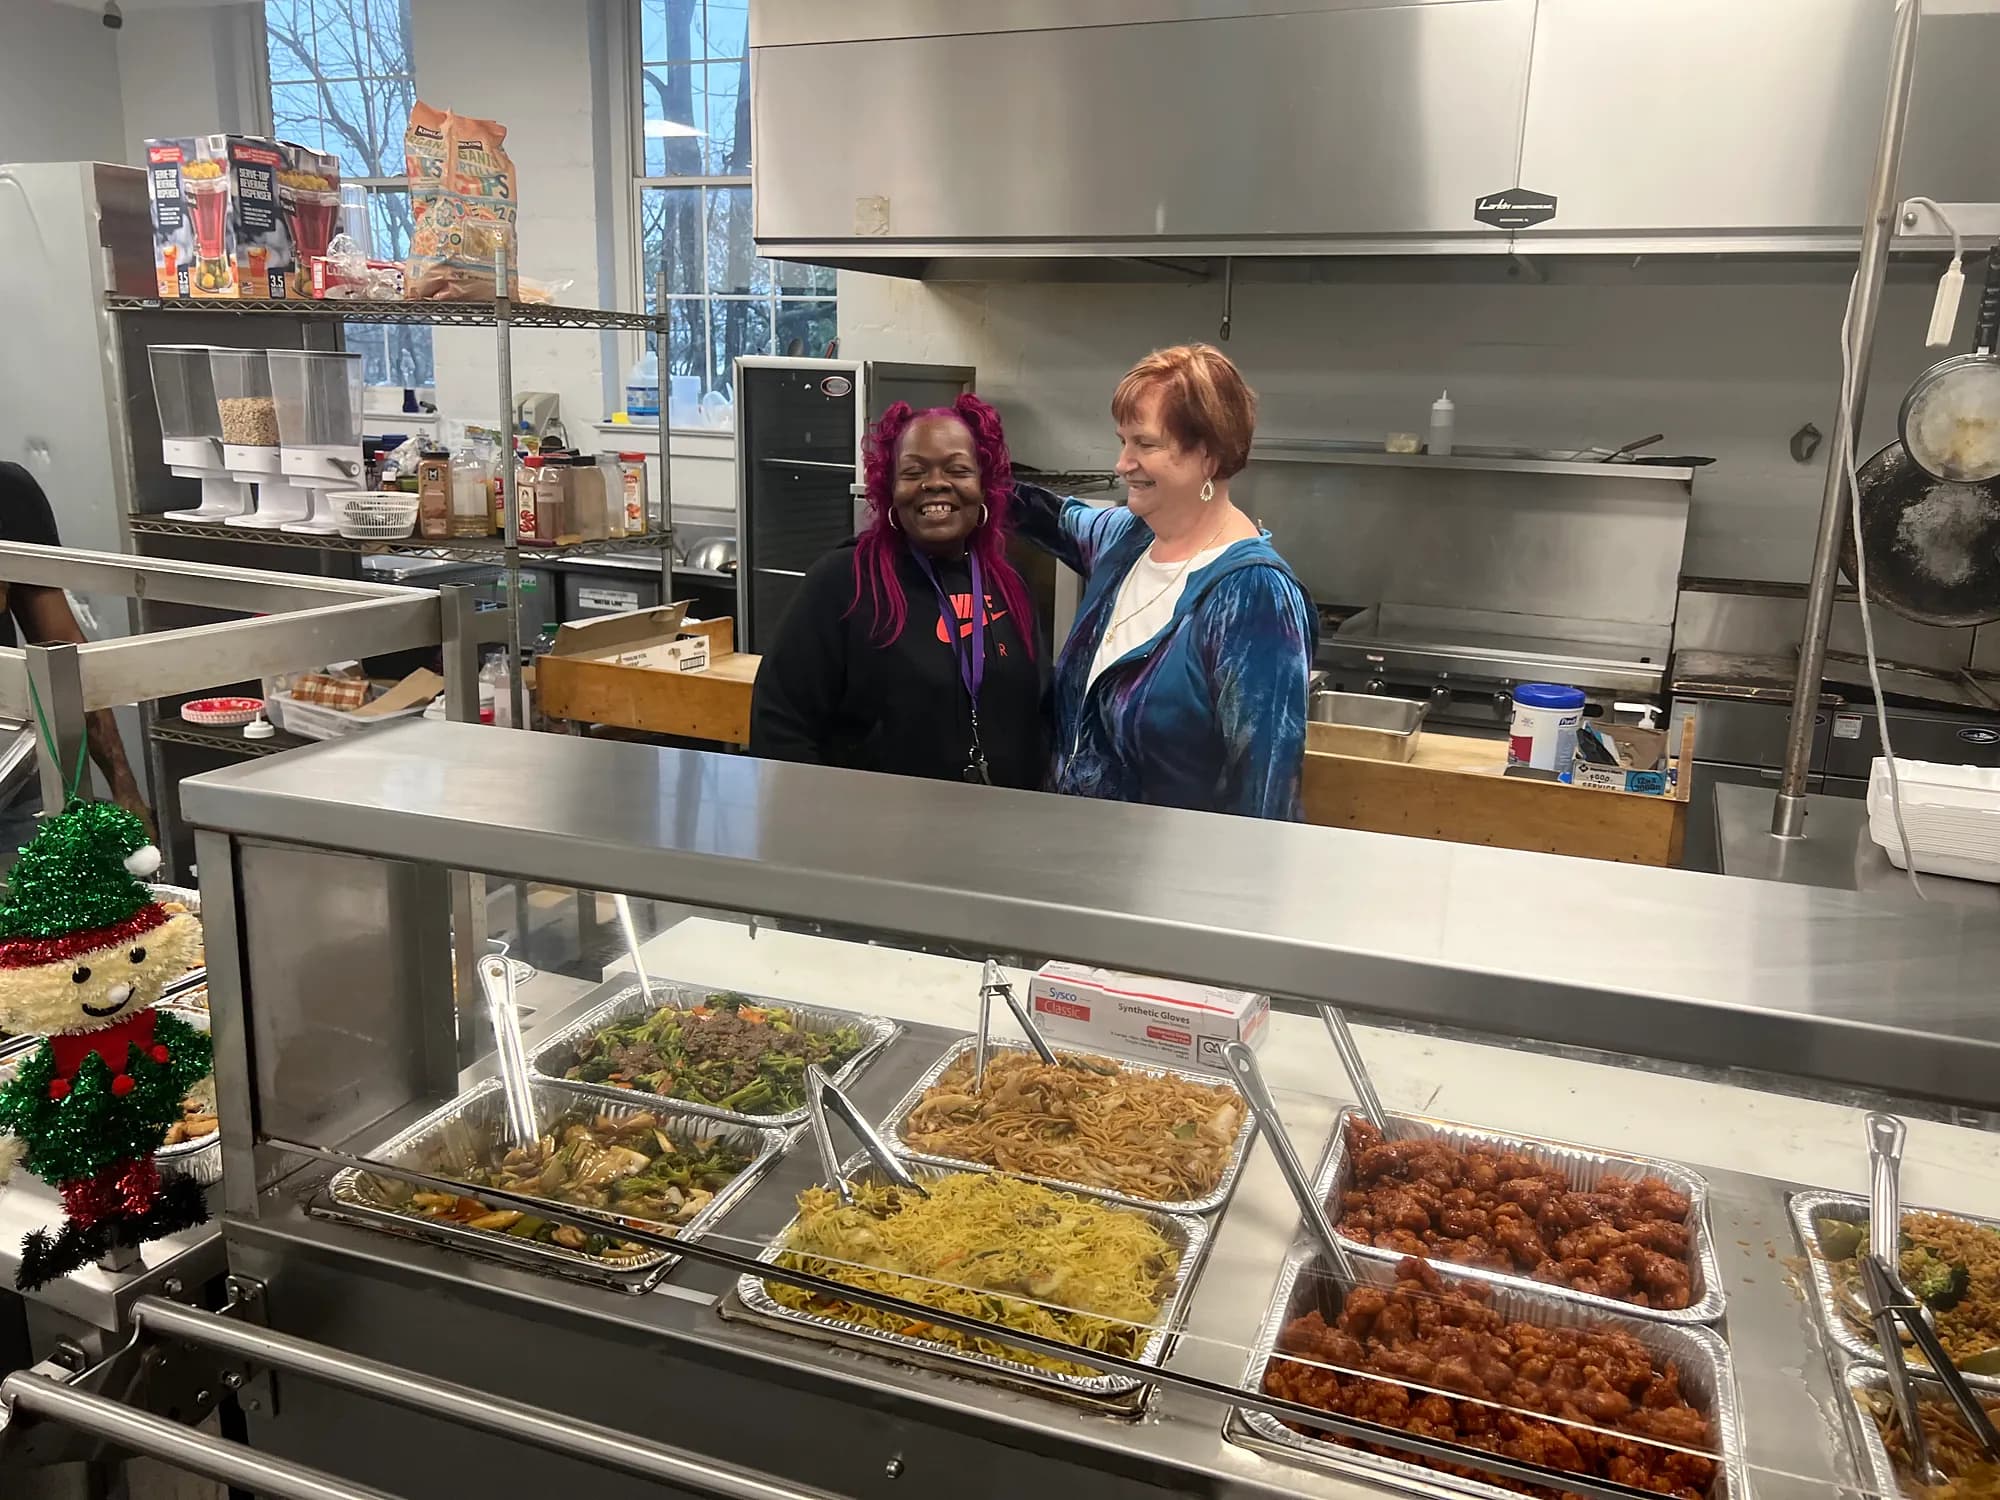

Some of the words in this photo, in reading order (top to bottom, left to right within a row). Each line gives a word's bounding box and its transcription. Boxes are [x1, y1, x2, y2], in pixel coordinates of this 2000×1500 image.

[270, 275, 284, 288] 3.5
[1590, 774, 1611, 782] FOOD
[1049, 987, 1077, 1002] Sysco
[1044, 1000, 1081, 1018] Classic
[1118, 1003, 1160, 1019] Synthetic
[1160, 1011, 1191, 1025] Gloves
